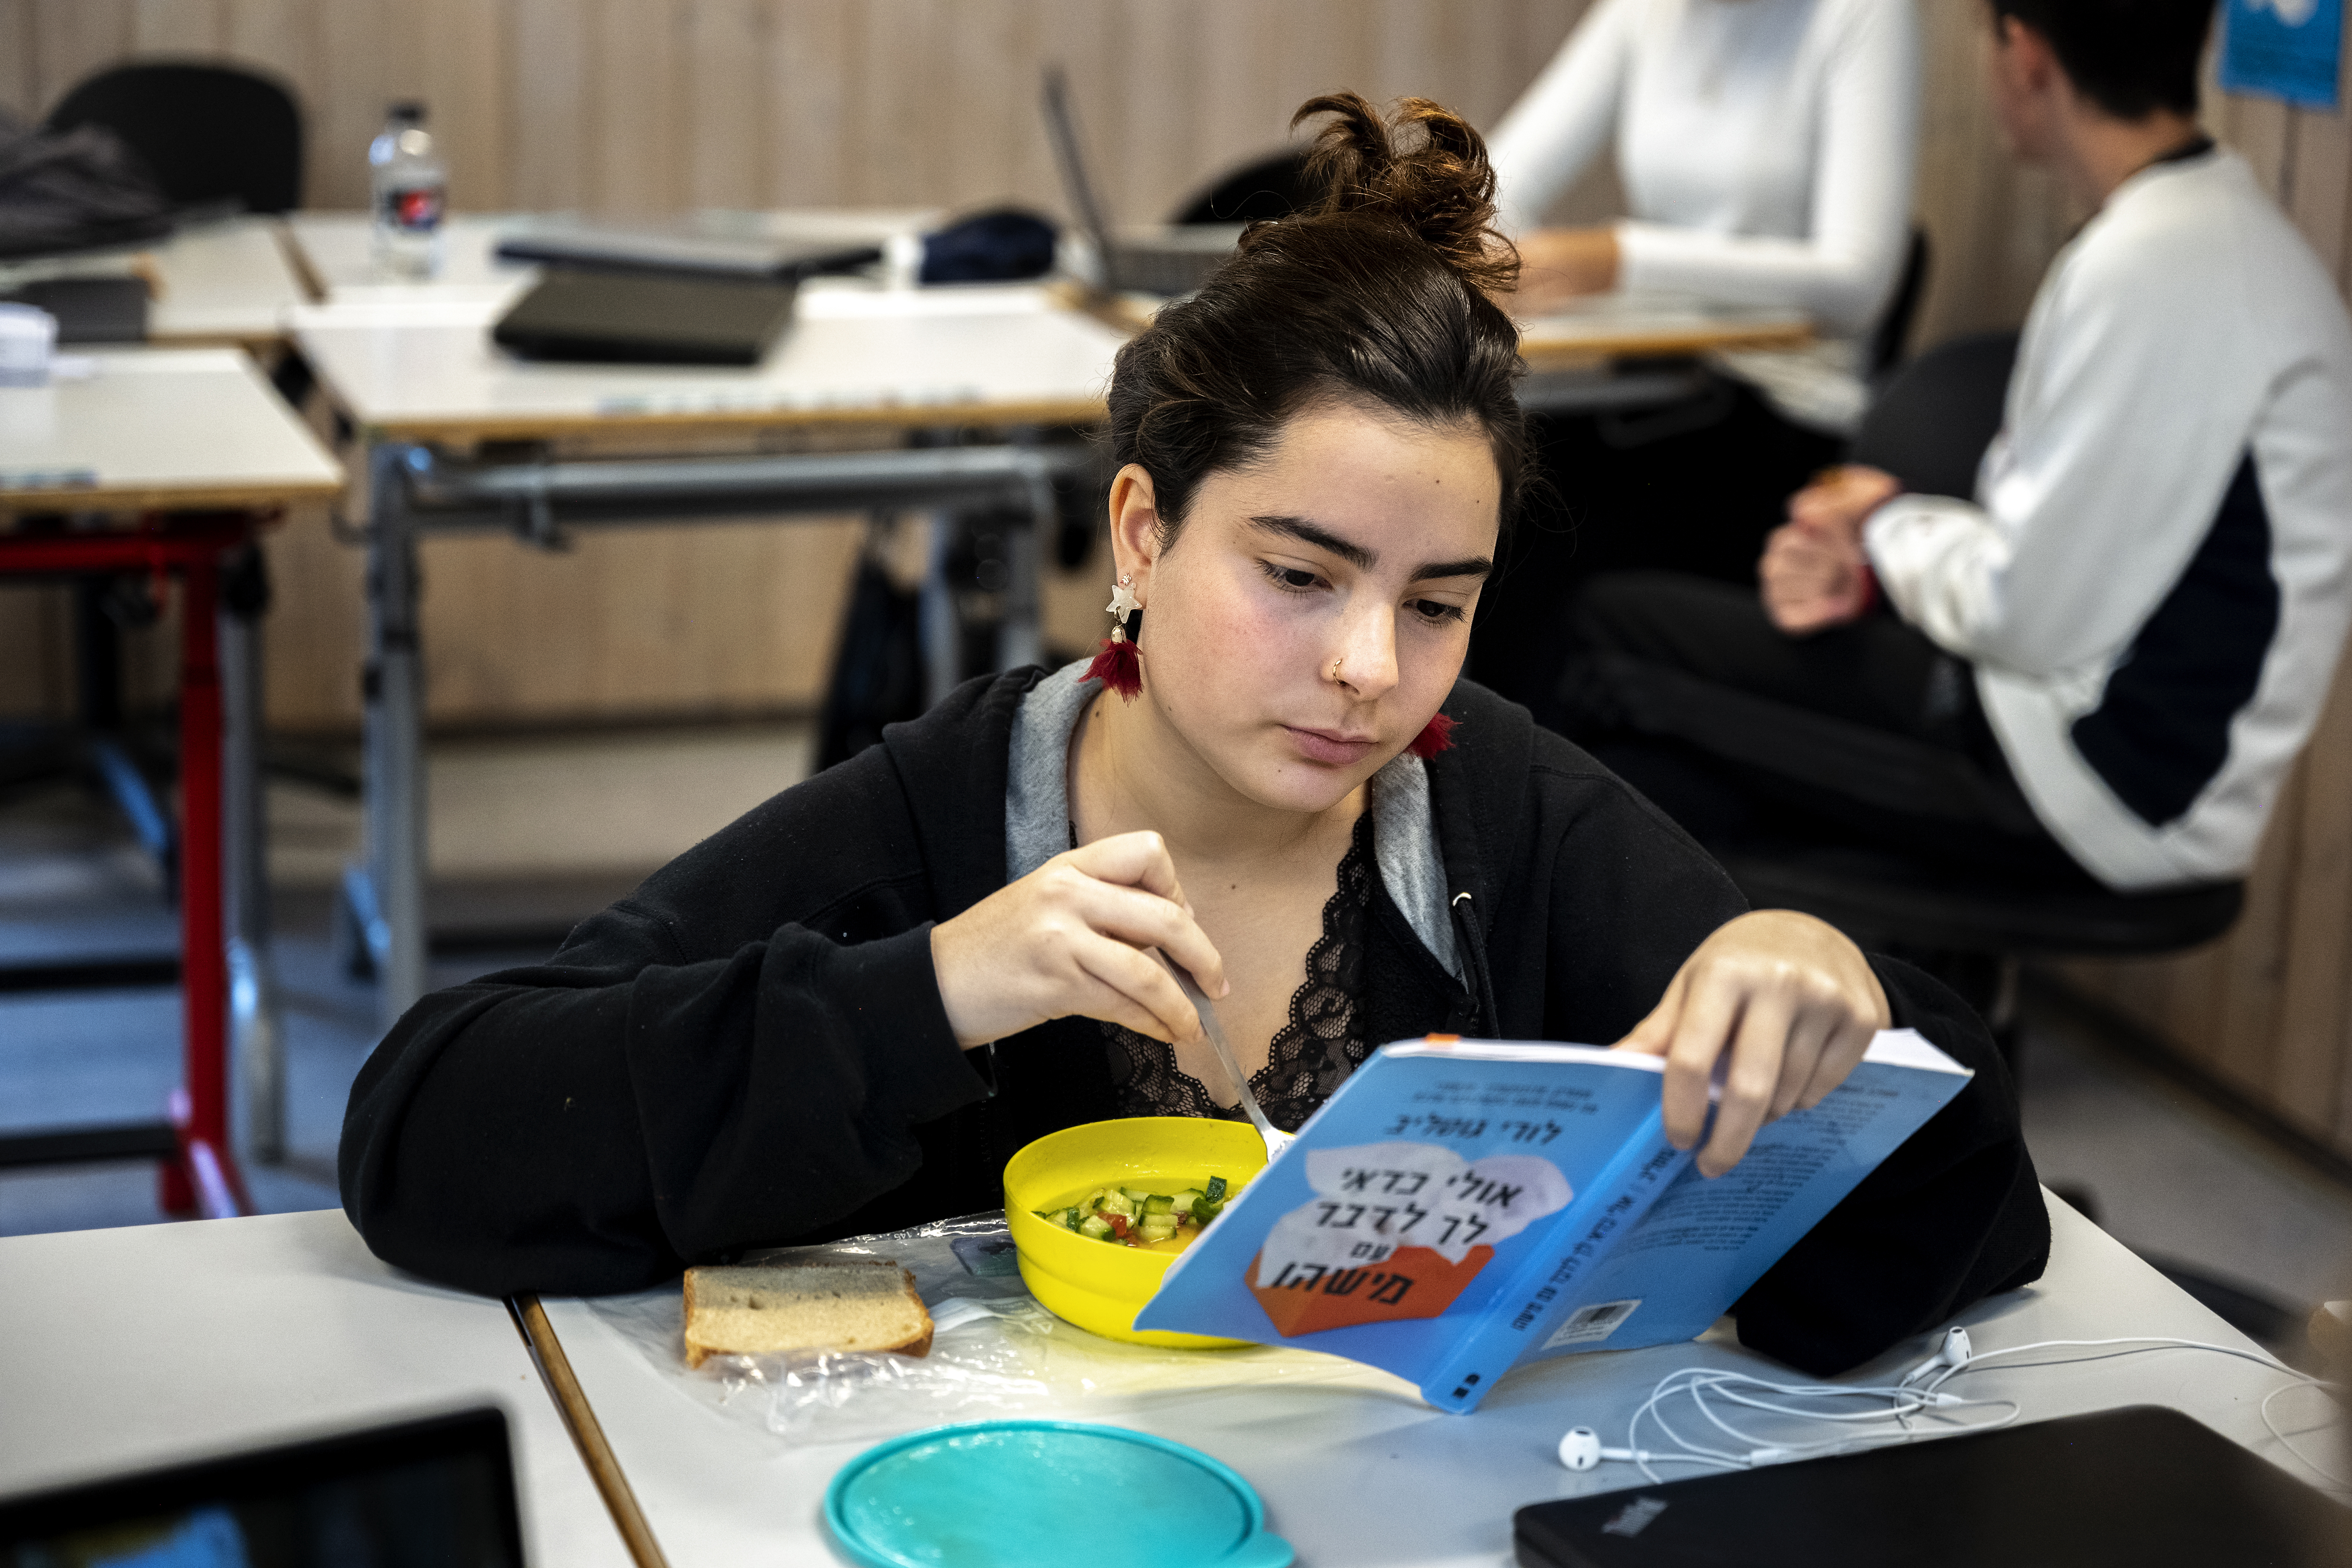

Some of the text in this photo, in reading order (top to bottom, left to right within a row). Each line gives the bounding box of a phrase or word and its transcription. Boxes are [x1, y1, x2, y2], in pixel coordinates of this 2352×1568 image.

[1500, 1118, 1562, 1145] לורי
[1342, 1167, 1523, 1208] אולי כדאי
[1317, 1201, 1489, 1245] לך לדבר
[1351, 1241, 1391, 1262] עם
[1272, 1261, 1415, 1305] מישהו
